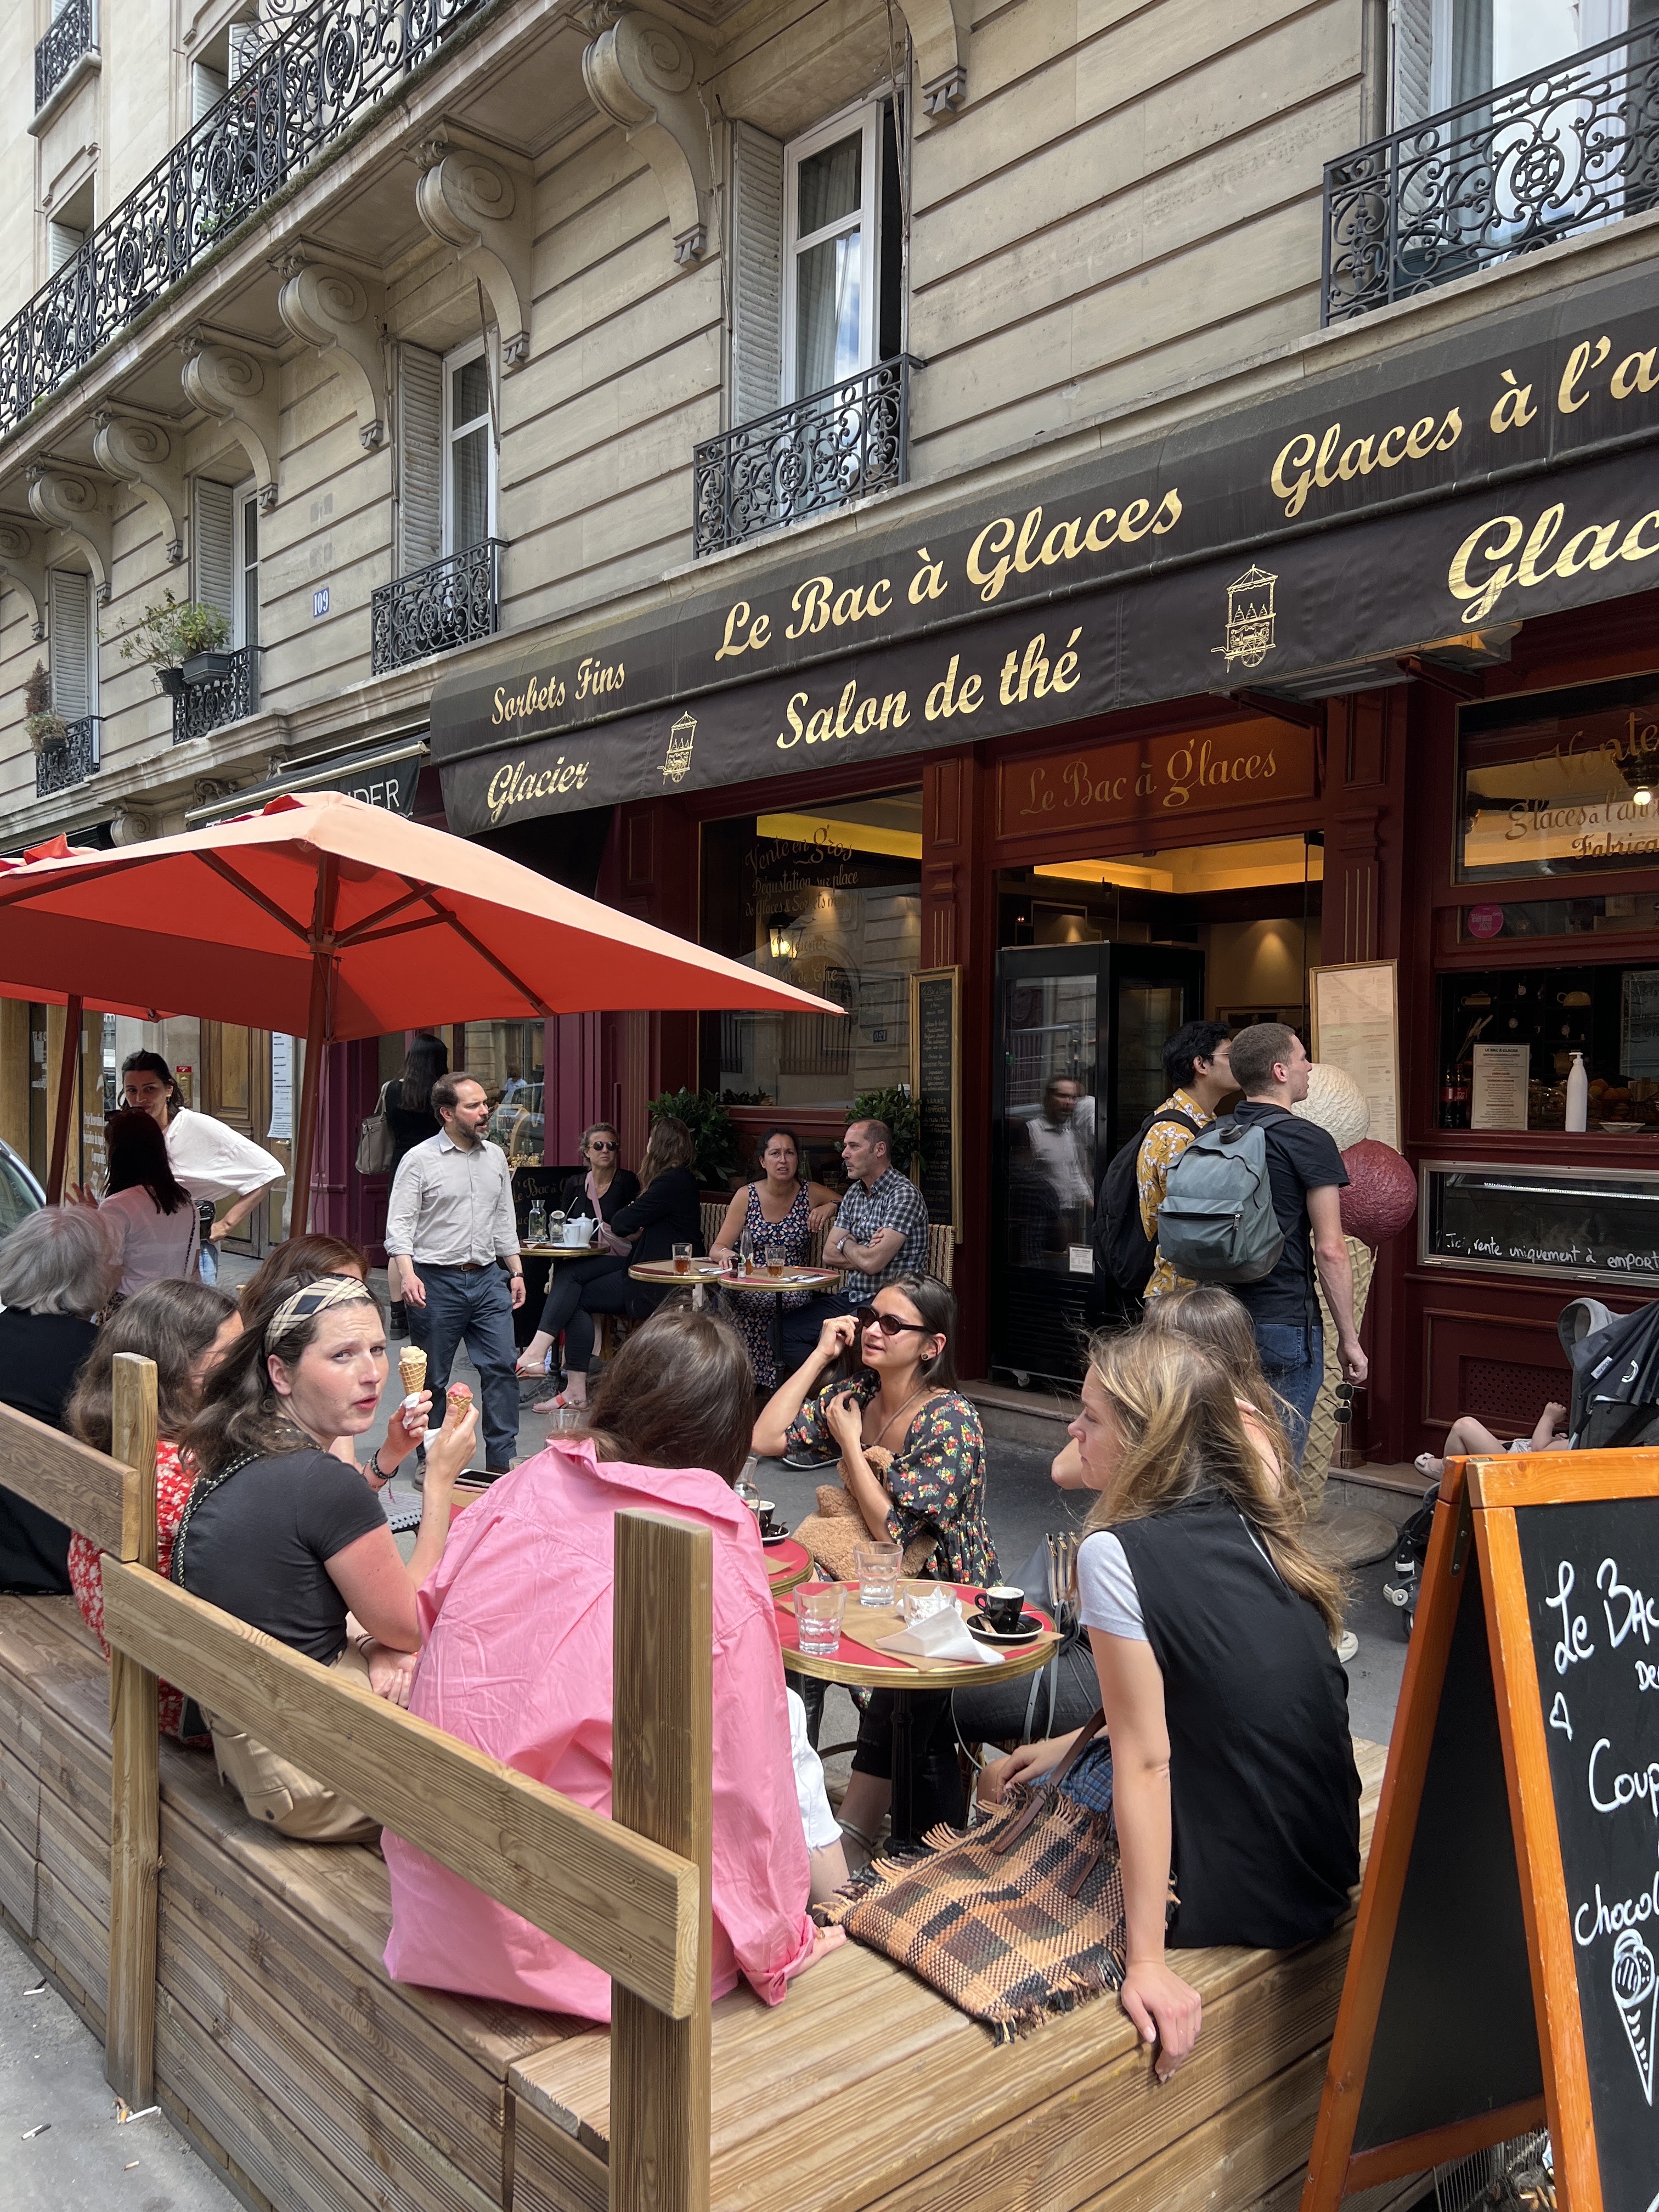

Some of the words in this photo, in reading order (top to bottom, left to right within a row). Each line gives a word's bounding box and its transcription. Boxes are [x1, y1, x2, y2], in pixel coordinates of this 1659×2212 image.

[1271, 407, 1462, 517] Glaces
[1491, 369, 1537, 433] à
[313, 590, 328, 615] 109
[715, 602, 771, 661] Le
[786, 577, 893, 639] Bac
[908, 548, 947, 604] à
[966, 488, 1182, 601] Glaces
[492, 676, 566, 725] Sorbets
[574, 657, 625, 700] Fins
[776, 680, 910, 749] Salon
[925, 654, 984, 721] de
[1000, 627, 1084, 705] thé
[488, 757, 589, 822] Glacier
[1020, 768, 1056, 814] Le
[1063, 758, 1127, 806] Bac
[1135, 763, 1157, 796] à
[745, 836, 789, 876] Vente
[792, 839, 809, 853] en
[809, 824, 853, 863] gros
[752, 870, 811, 901] Dégustation
[833, 864, 859, 893] place
[523, 1177, 549, 1198] Bac
[1510, 1245, 1581, 1264] uniquement
[1585, 1248, 1596, 1263] à
[1546, 1560, 1594, 1674] Le
